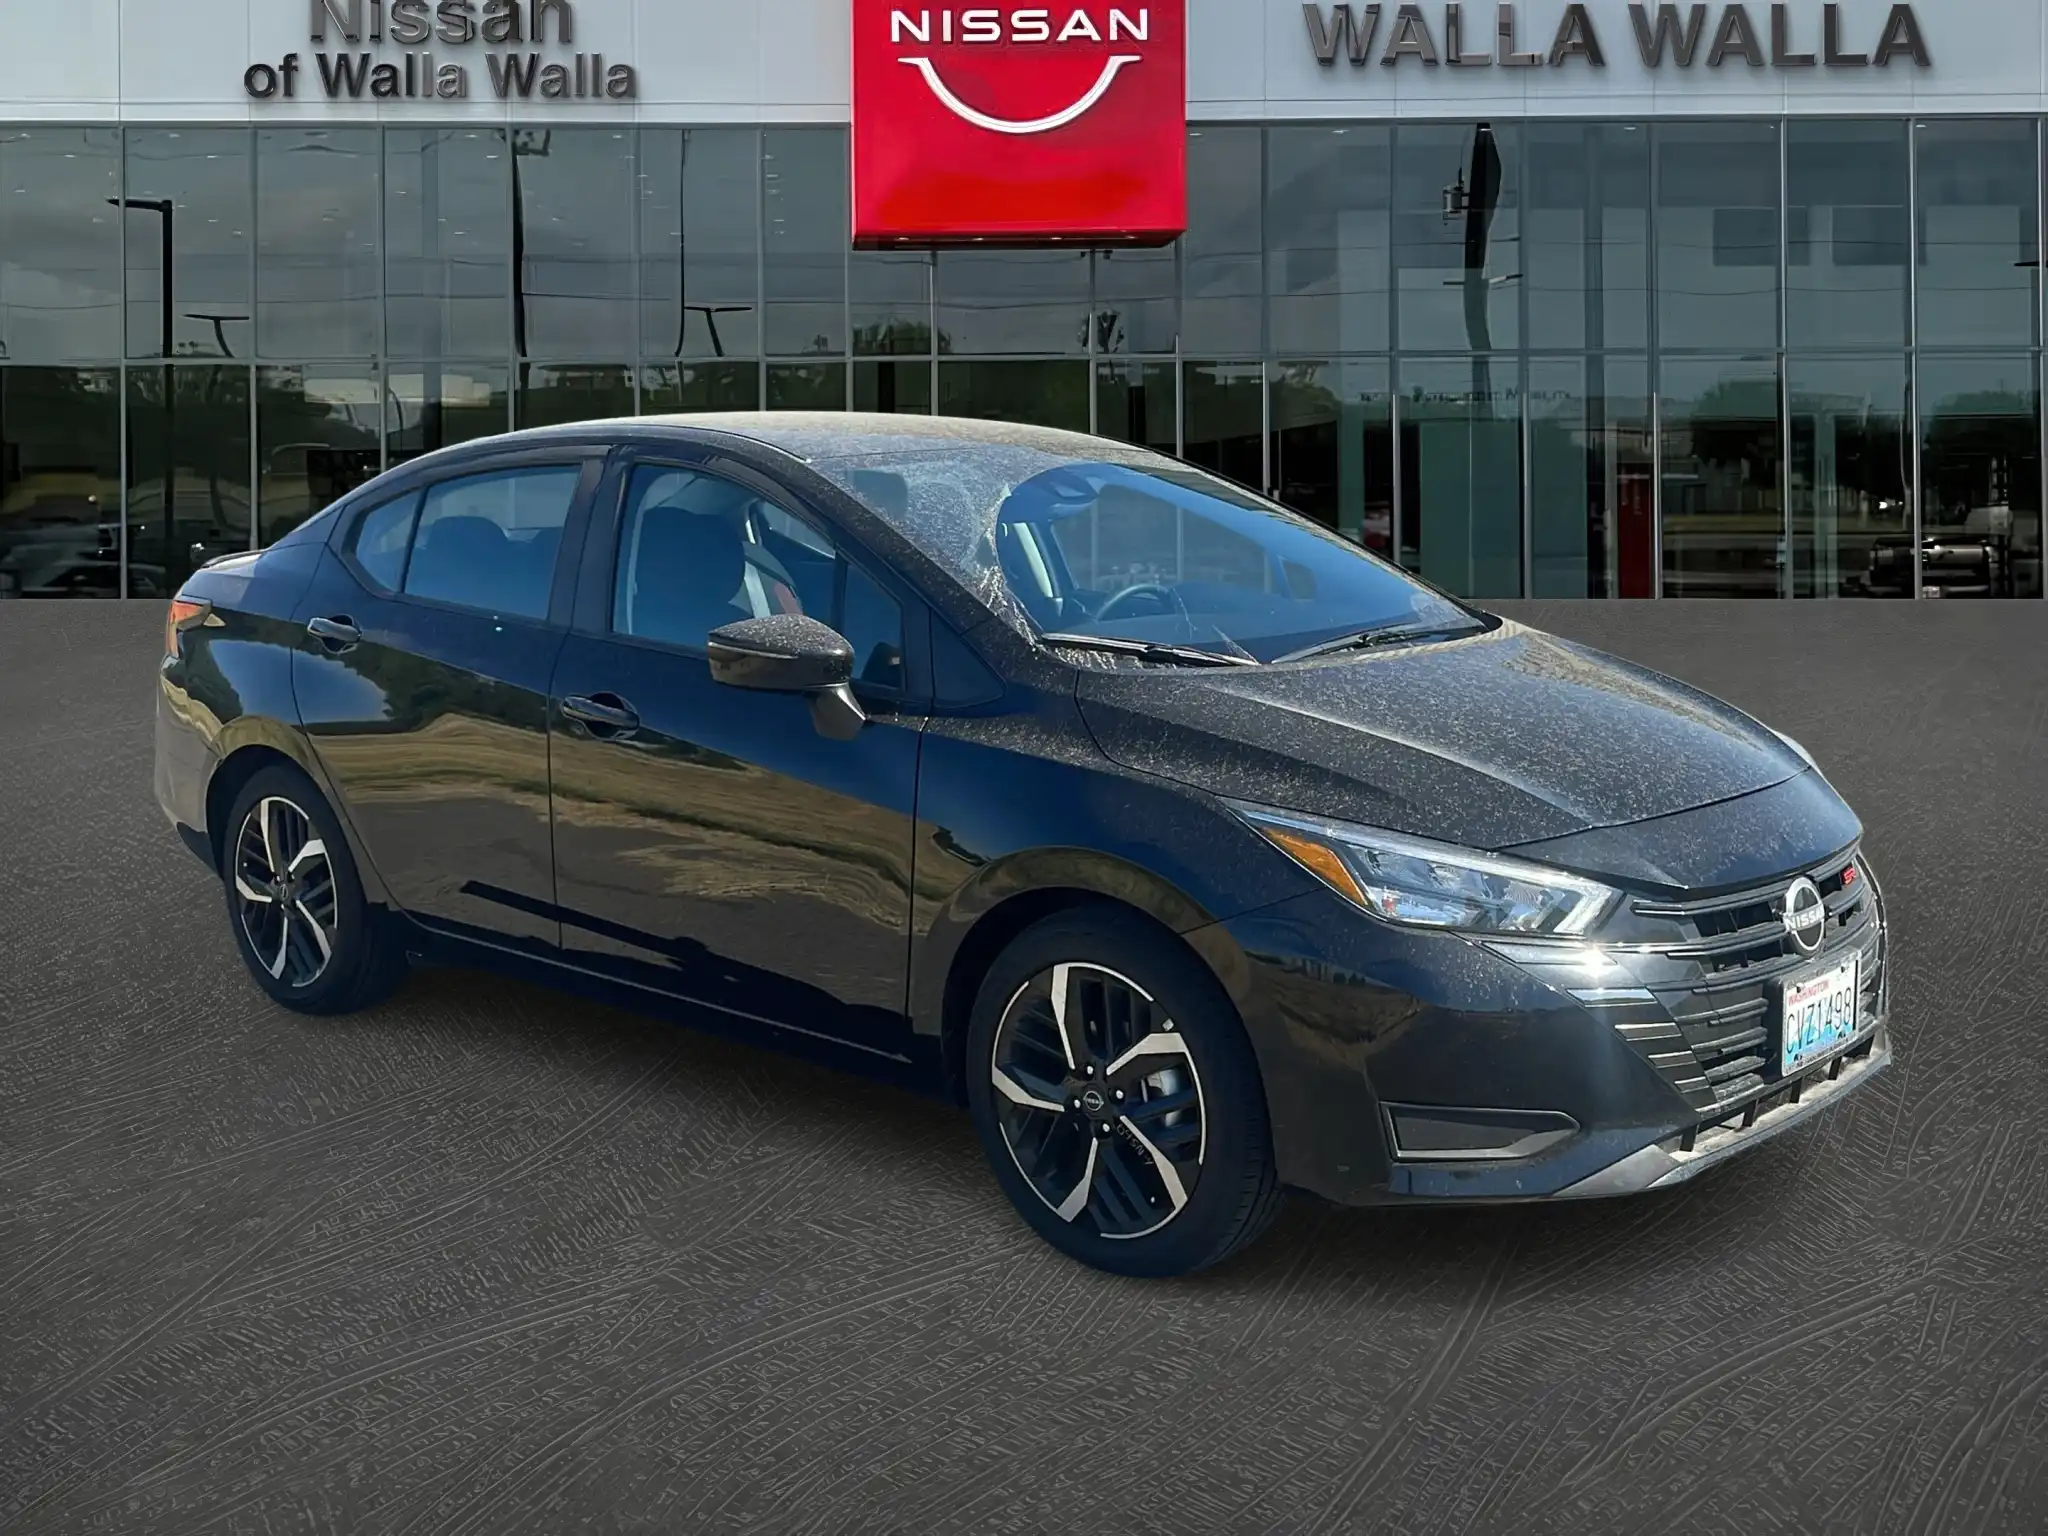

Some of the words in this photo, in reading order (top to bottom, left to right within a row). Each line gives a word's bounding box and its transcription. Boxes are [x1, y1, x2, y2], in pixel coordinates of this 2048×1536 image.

[310, 0, 572, 43] Nissan
[890, 8, 1149, 43] NISSAN
[1303, 3, 1606, 67] WALLA
[1627, 3, 1931, 67] WALLA
[243, 52, 299, 99] of
[314, 52, 467, 99] Walla
[484, 52, 638, 99] Walla
[1784, 904, 1825, 931] NISSA
[1786, 986, 1852, 1054] CVZ1498
